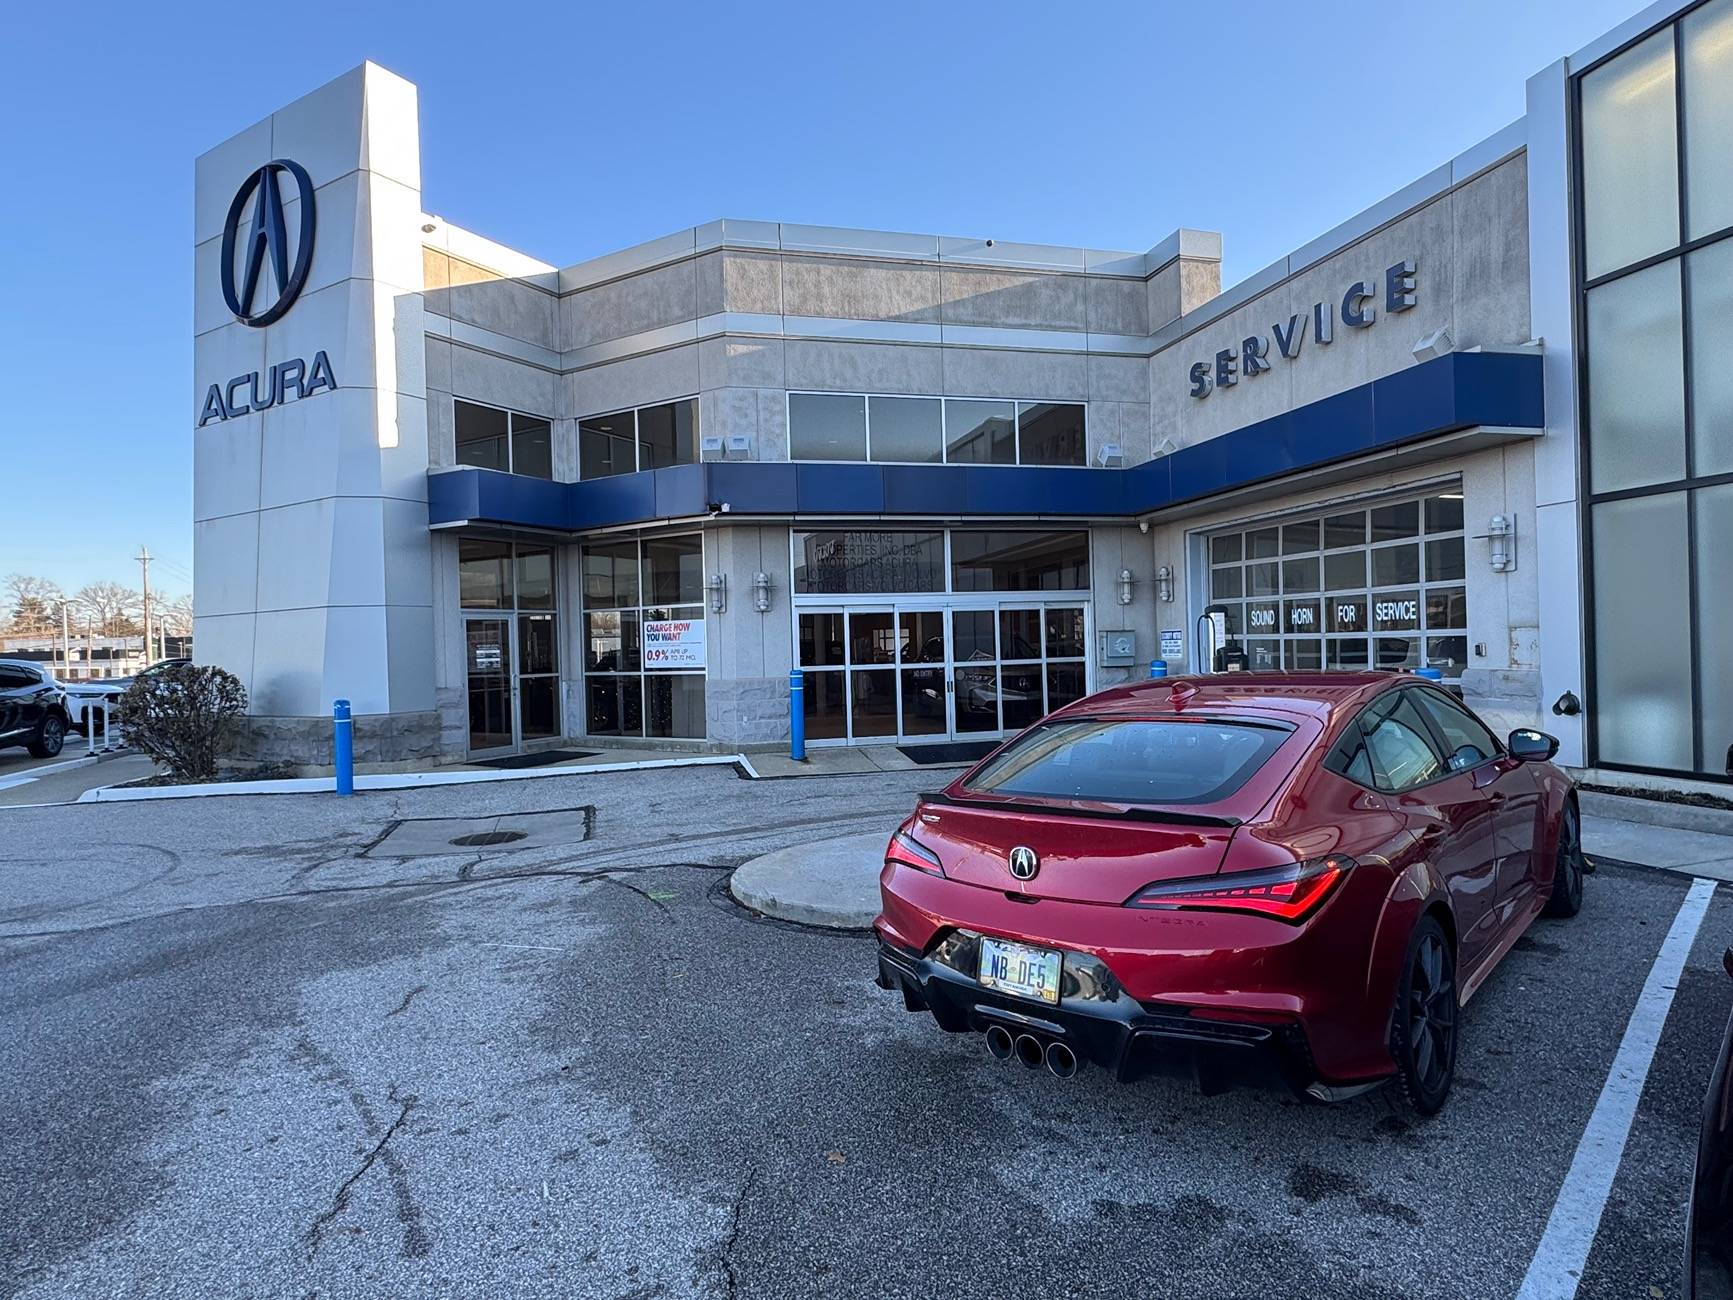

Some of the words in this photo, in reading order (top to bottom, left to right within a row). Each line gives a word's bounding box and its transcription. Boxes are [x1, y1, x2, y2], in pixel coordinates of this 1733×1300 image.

[1189, 259, 1417, 400] SERVICE
[198, 350, 338, 427] ACURA
[1251, 609, 1275, 627] SOUND
[1291, 607, 1314, 625] HORN
[1338, 604, 1356, 623] FOR
[1375, 600, 1417, 622] SERVICE
[646, 623, 672, 633] CHARGE
[673, 622, 690, 632] HOW
[646, 633, 660, 642] YOU
[661, 632, 681, 641] WANT
[646, 649, 668, 661] 0.9%
[990, 954, 1009, 981] NB
[1017, 960, 1047, 989] DE5
